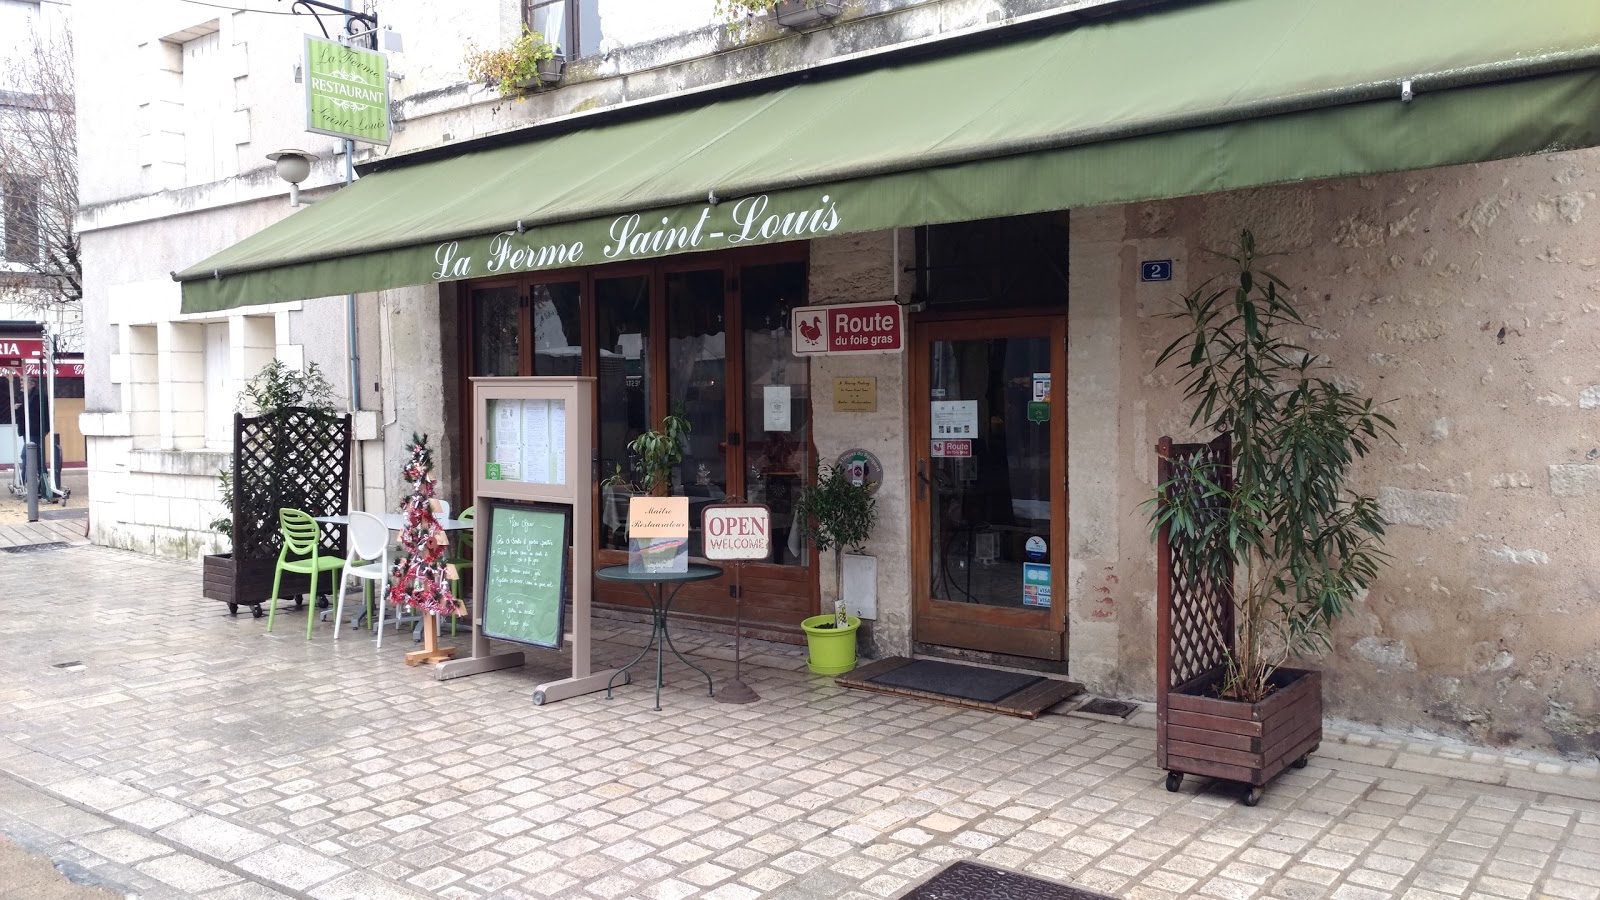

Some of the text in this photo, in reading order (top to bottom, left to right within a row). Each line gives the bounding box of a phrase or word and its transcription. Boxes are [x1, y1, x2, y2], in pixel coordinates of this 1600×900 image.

[316, 47, 380, 79] La Ferme
[311, 77, 384, 103] RESTAURANT
[311, 108, 385, 131] Saint-Louis
[432, 194, 841, 280] La Ferme Saint-Louis
[1151, 264, 1161, 278] 2
[835, 312, 894, 334] Route
[835, 335, 893, 347] du foie gras
[946, 442, 969, 450] Route
[644, 507, 672, 515] Maître
[631, 520, 685, 528] Restaurateur
[709, 516, 766, 537] OPEN
[710, 538, 765, 550] WELCOME
[1027, 569, 1048, 580] CB
